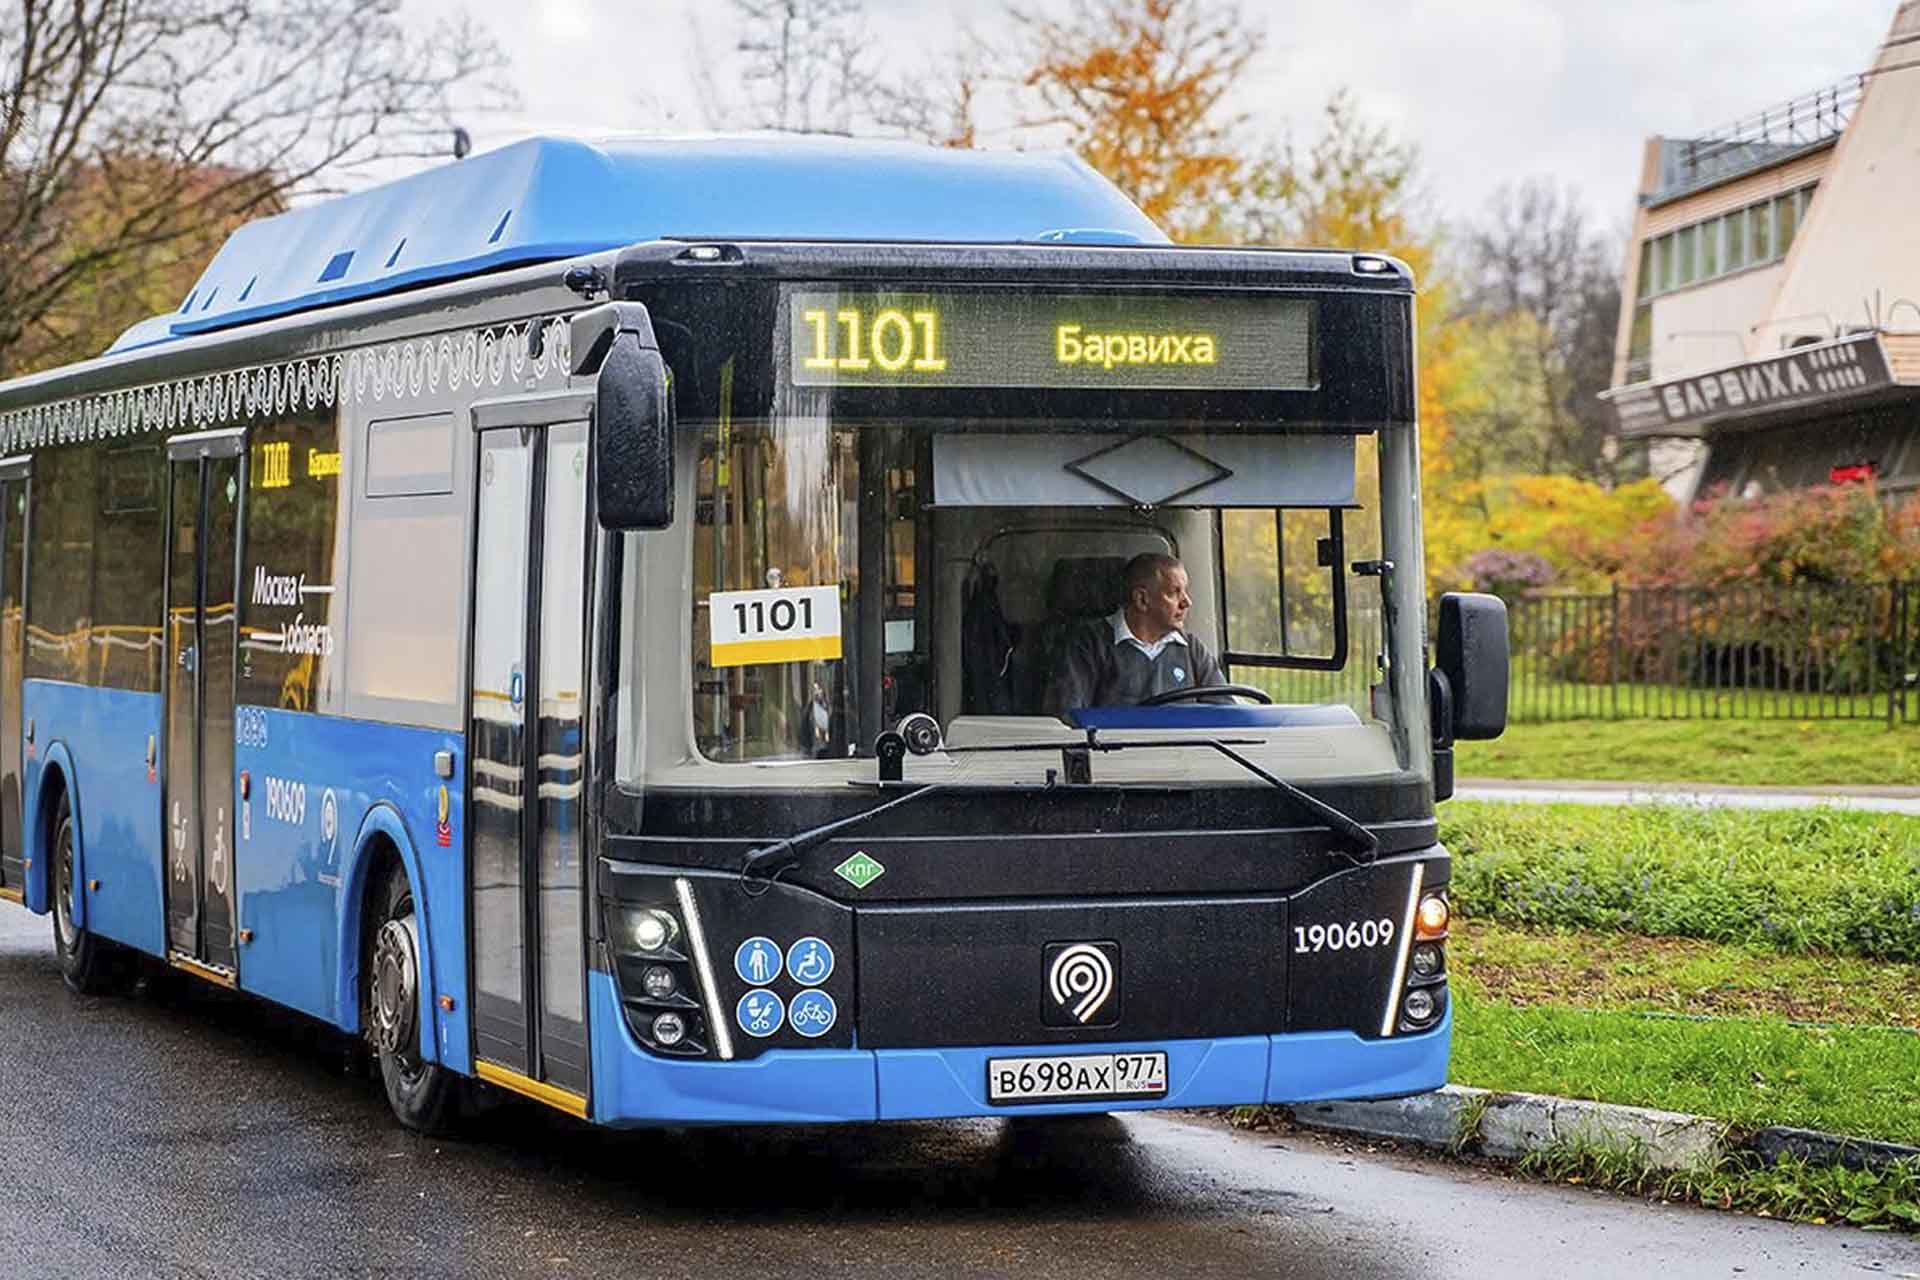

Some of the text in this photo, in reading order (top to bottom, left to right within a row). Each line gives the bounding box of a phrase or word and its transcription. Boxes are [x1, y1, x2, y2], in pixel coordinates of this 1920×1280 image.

[805, 309, 1217, 371] 1101 Барвиха
[1662, 357, 1811, 419] БАРВИХА
[262, 442, 290, 488] 1101
[252, 565, 297, 605] Москва
[287, 612, 333, 656] область
[733, 597, 812, 634] 1101
[265, 775, 306, 825] 190609
[846, 863, 875, 877] КПГ
[1294, 918, 1395, 953] 190609
[1115, 1056, 1157, 1081] 977
[1126, 1080, 1147, 1090] RUS
